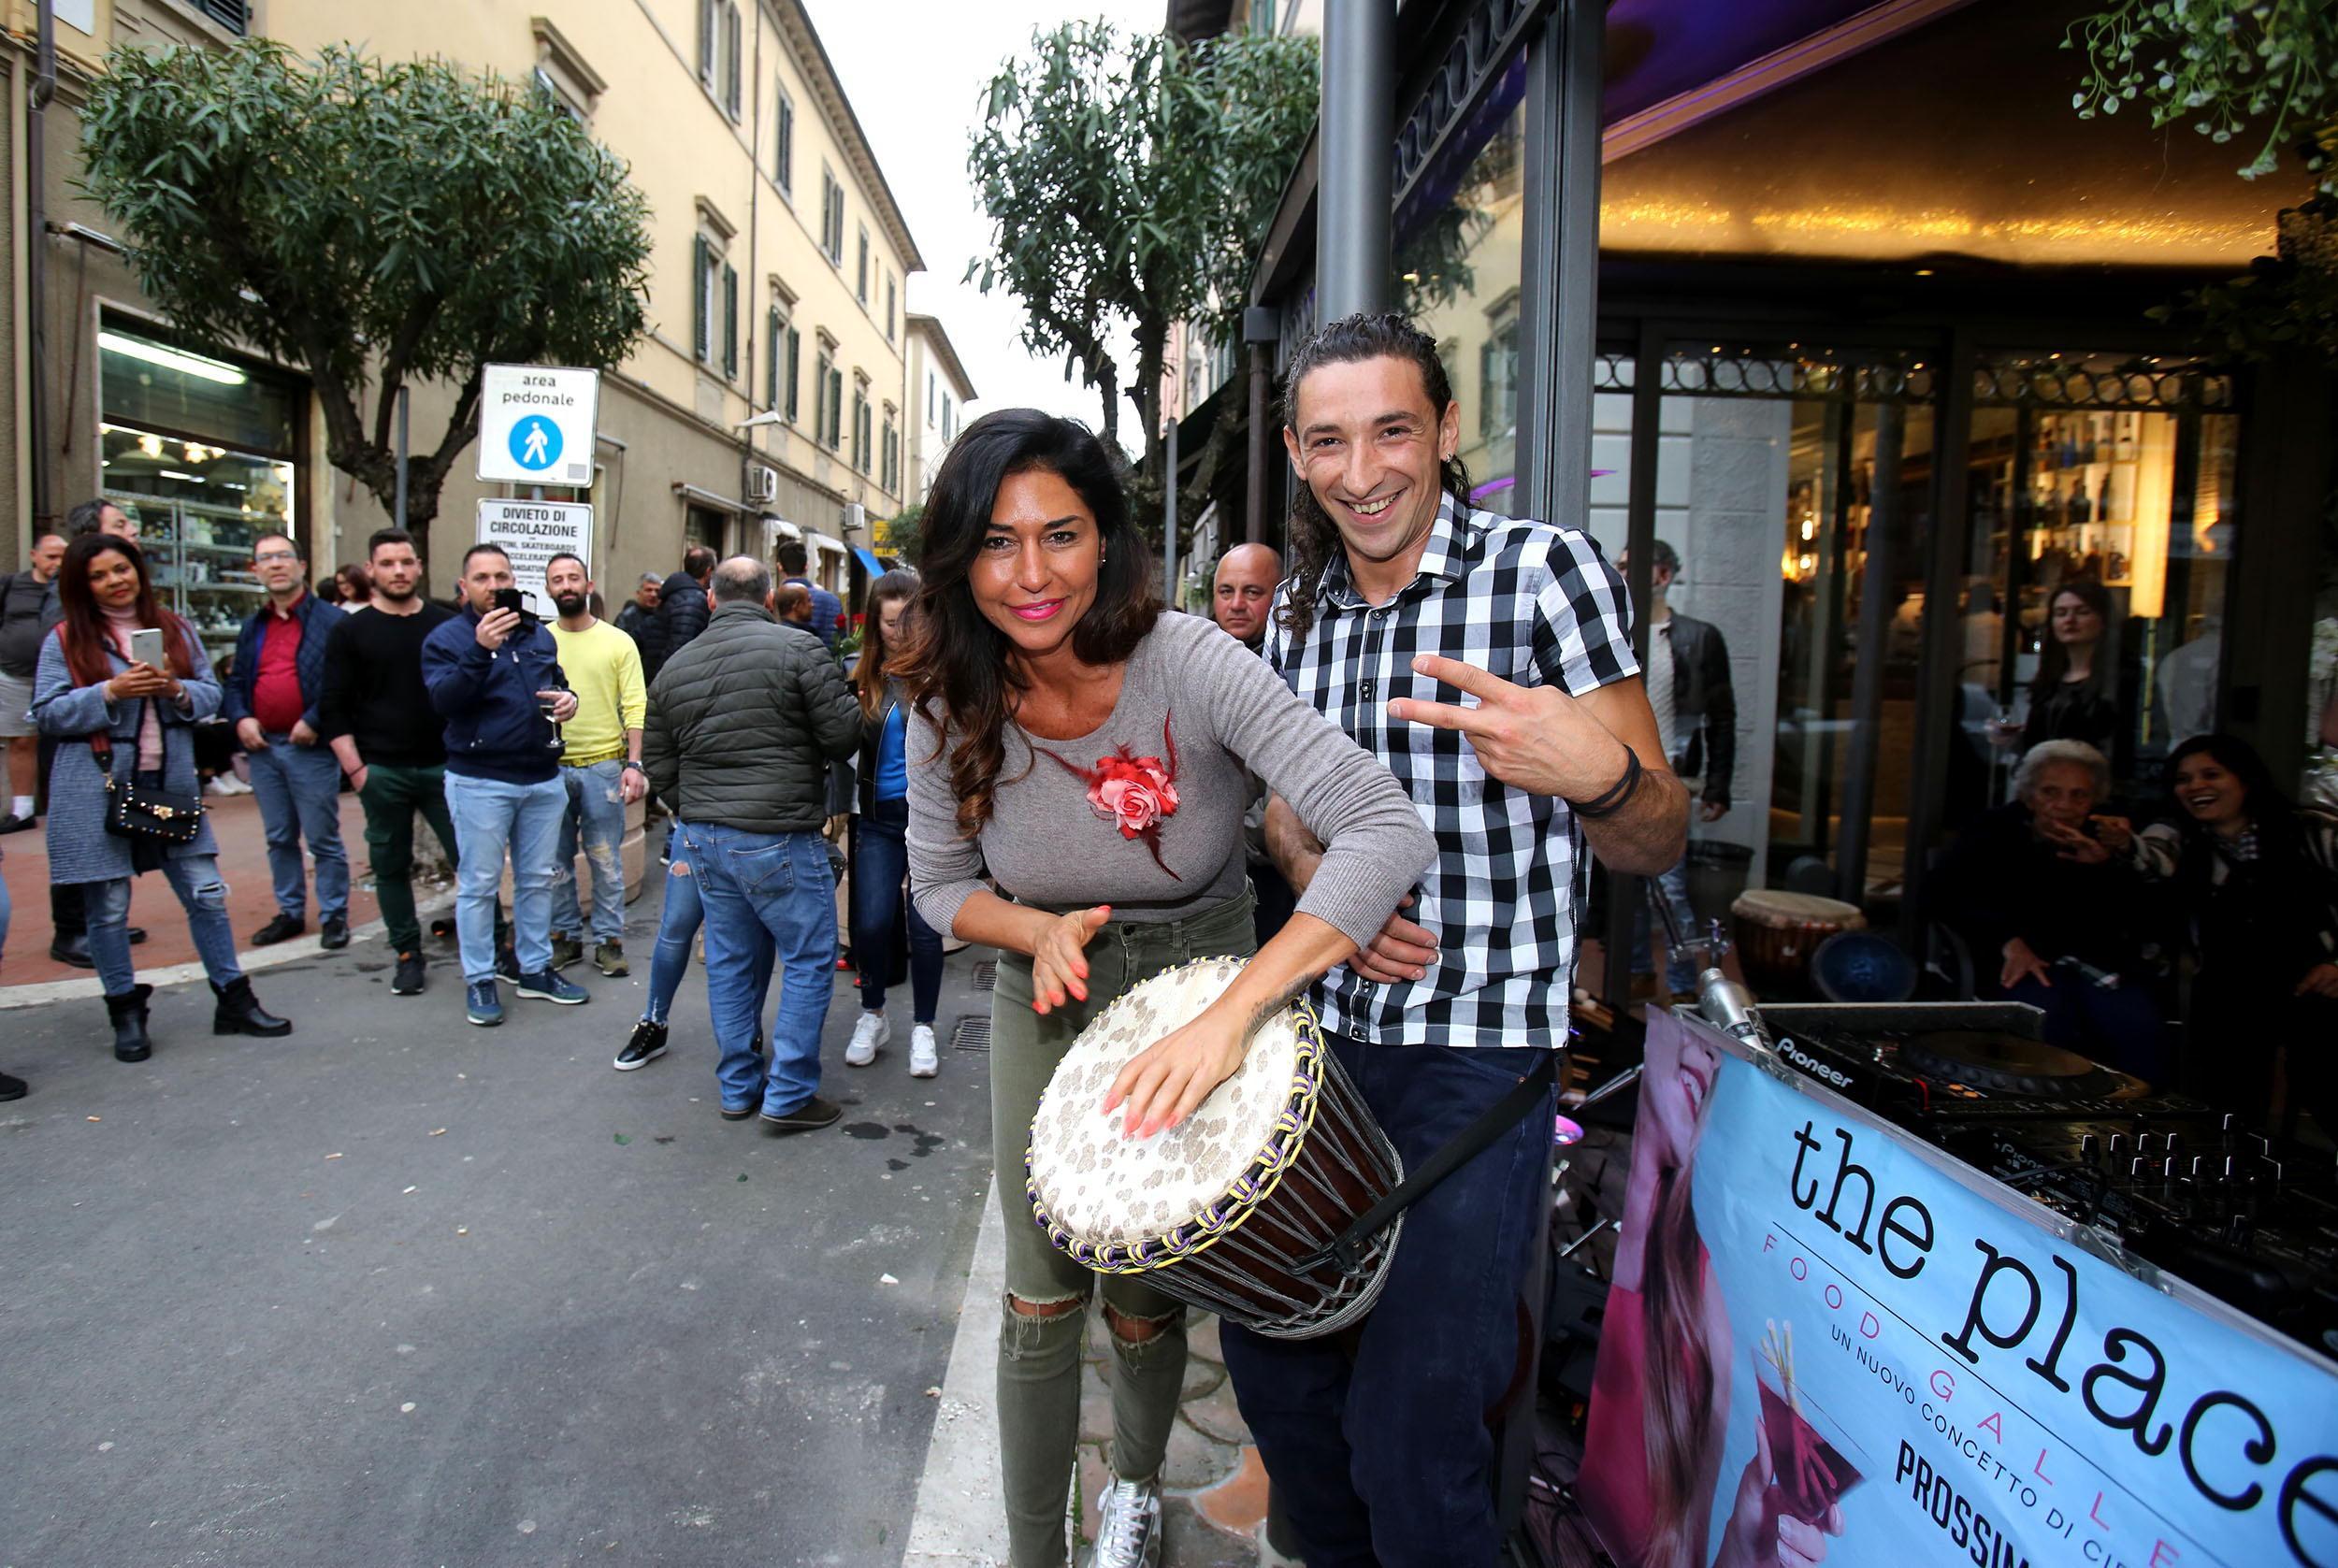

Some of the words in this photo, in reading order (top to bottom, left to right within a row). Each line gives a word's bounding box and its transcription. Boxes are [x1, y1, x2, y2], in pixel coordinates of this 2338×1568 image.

[523, 375, 556, 387] area
[502, 390, 575, 407] pedonale
[490, 522, 578, 538] CIRCOLAZIONE
[503, 508, 549, 521] DIVIETO
[553, 511, 566, 522] DI
[1776, 1037, 1854, 1088] Pioneer
[1763, 1233, 1880, 1339] FOOD
[1790, 1120, 1934, 1279] the
[1941, 1237, 2338, 1568] place
[1831, 1324, 1851, 1351] UN
[1856, 1346, 1915, 1404] NUOVO
[1921, 1403, 2037, 1507] CONCETTO
[2045, 1507, 2073, 1539] DI
[2083, 1540, 2128, 1568] CI
